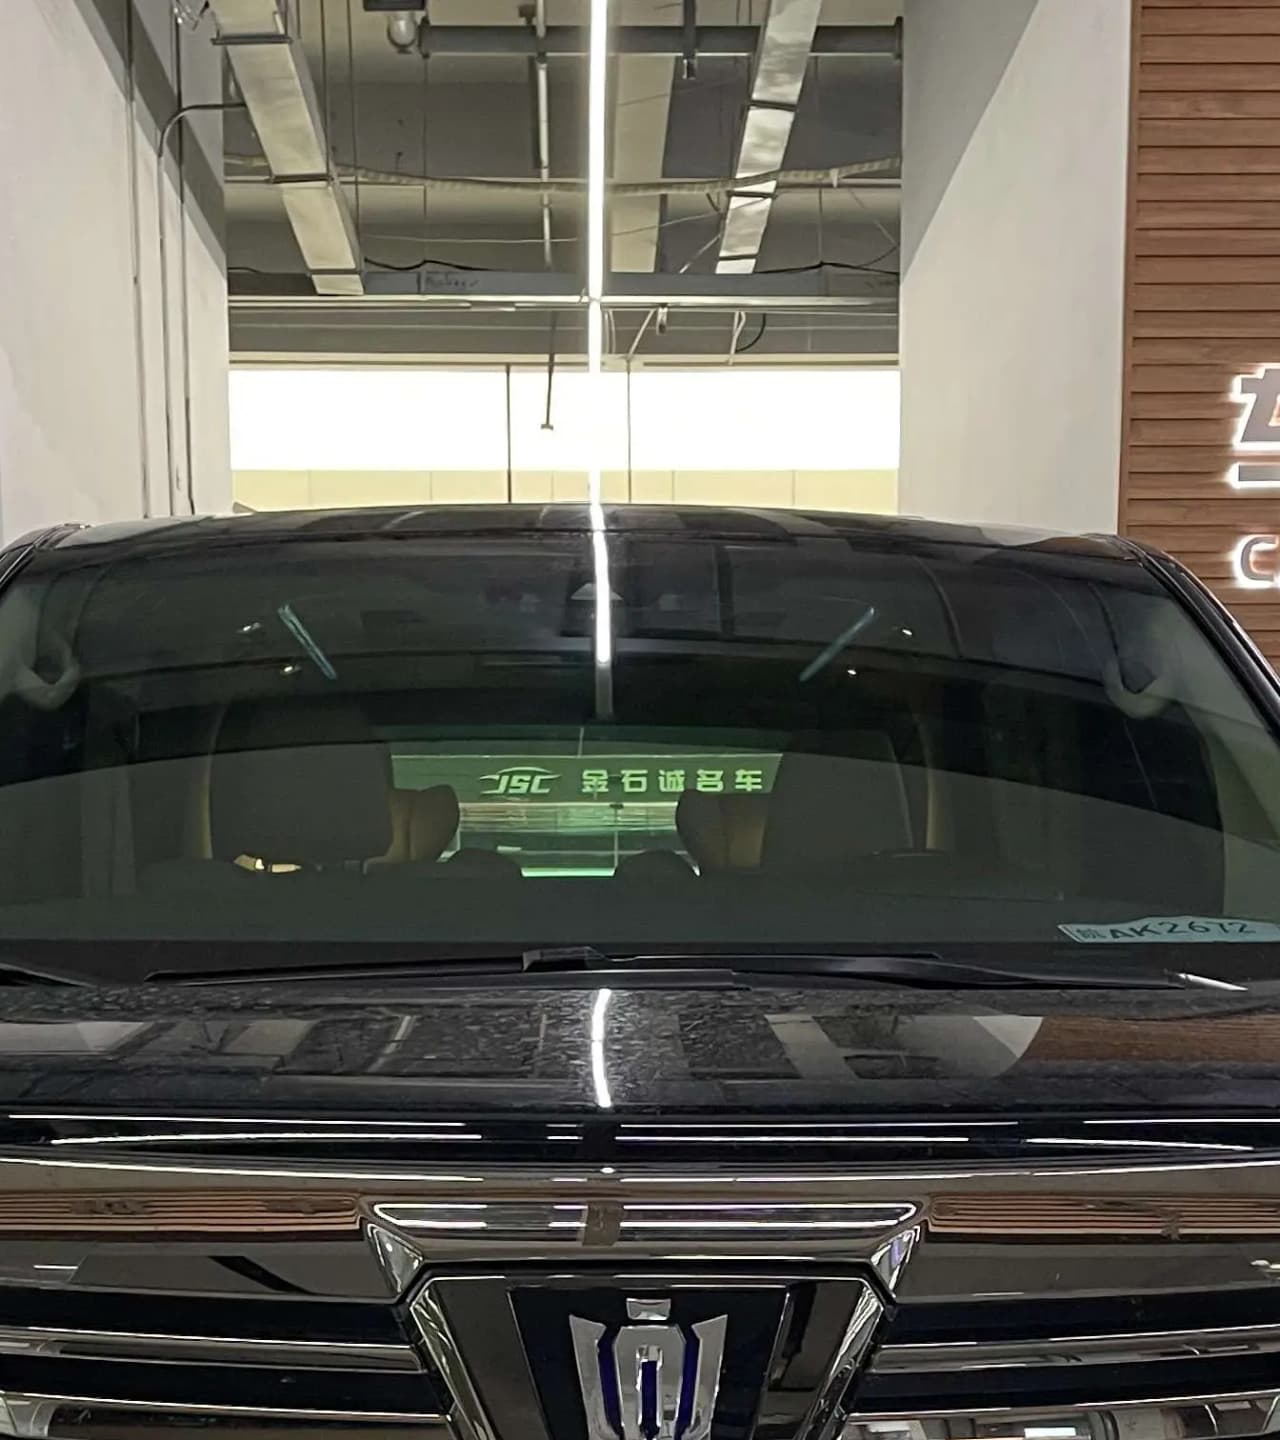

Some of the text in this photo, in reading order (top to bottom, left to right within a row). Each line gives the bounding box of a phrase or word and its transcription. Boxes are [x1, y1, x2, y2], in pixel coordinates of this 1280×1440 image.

[581, 769, 763, 793] 金石诚名车
